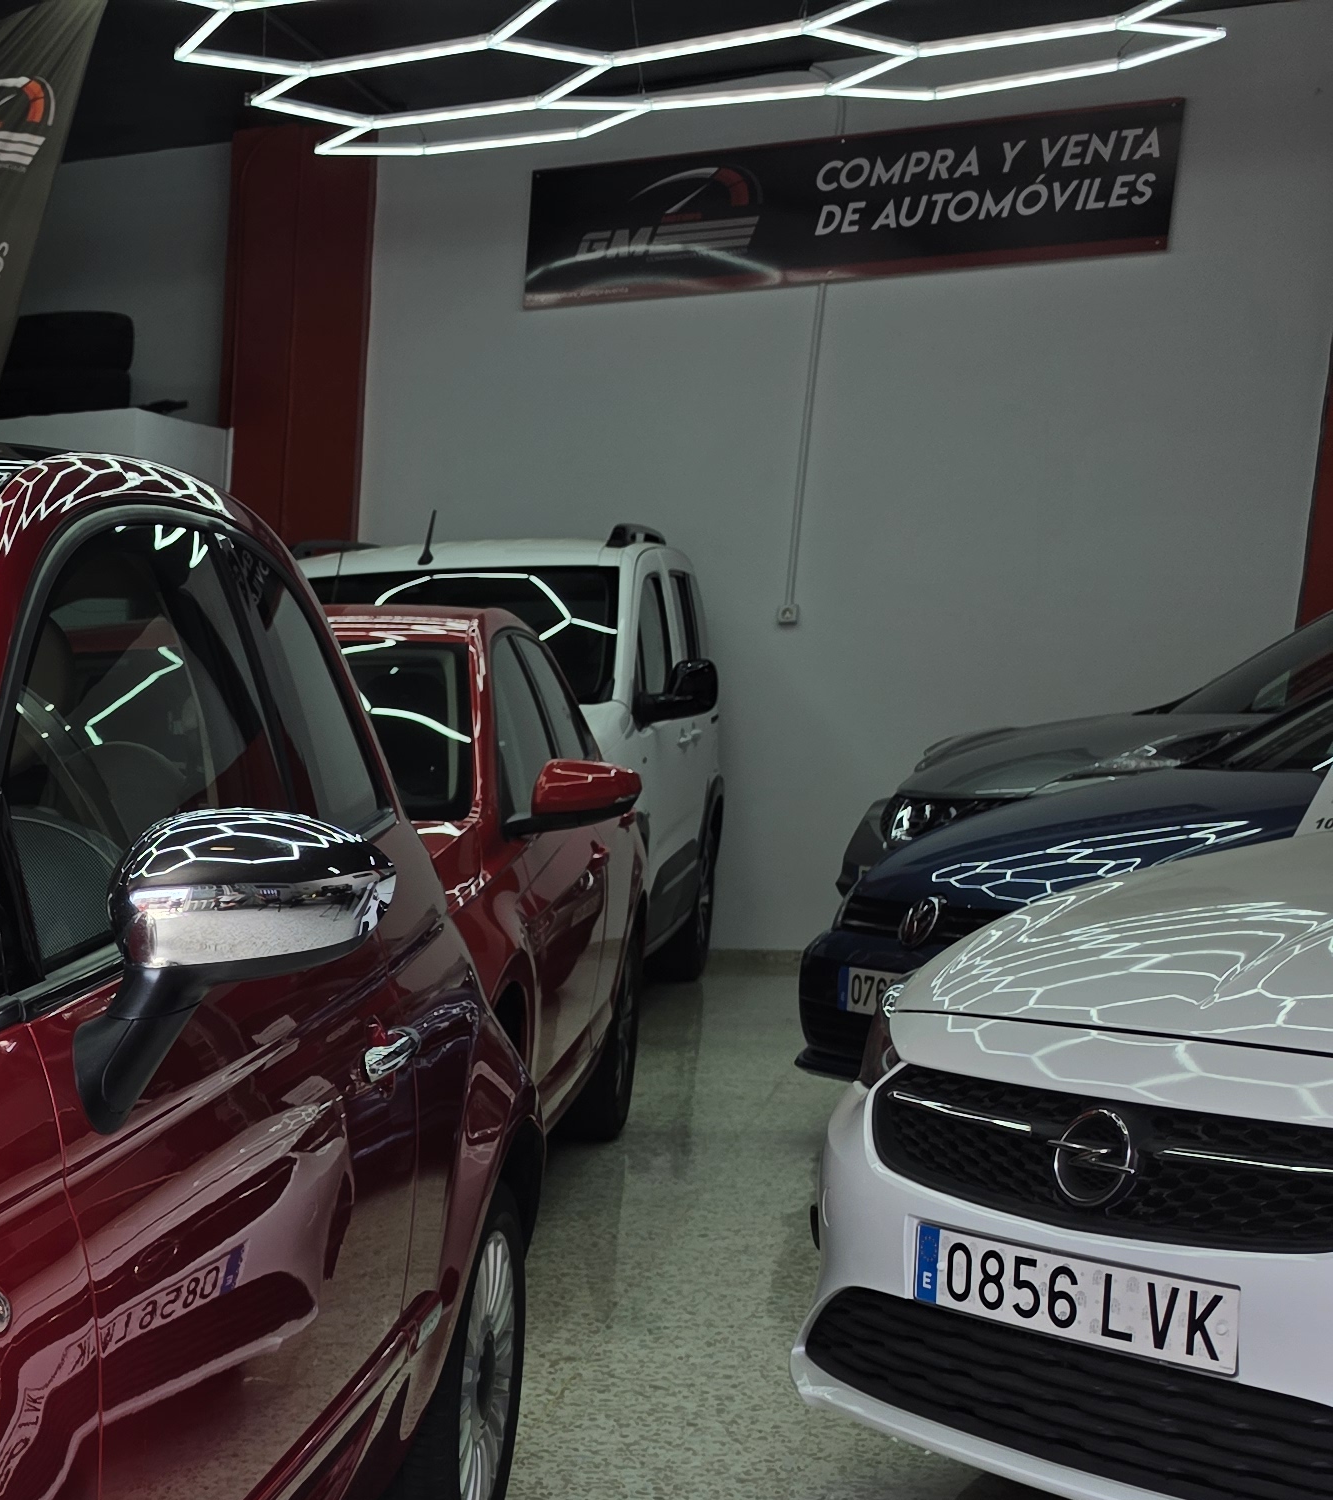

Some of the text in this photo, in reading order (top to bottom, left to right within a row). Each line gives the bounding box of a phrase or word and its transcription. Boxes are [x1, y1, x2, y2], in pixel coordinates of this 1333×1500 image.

[815, 126, 1161, 192] COMPRA Y VENTA
[814, 172, 1158, 237] DE AUTOMÓVILES
[922, 1271, 932, 1290] E
[945, 1241, 1224, 1362] 0856 LVK
